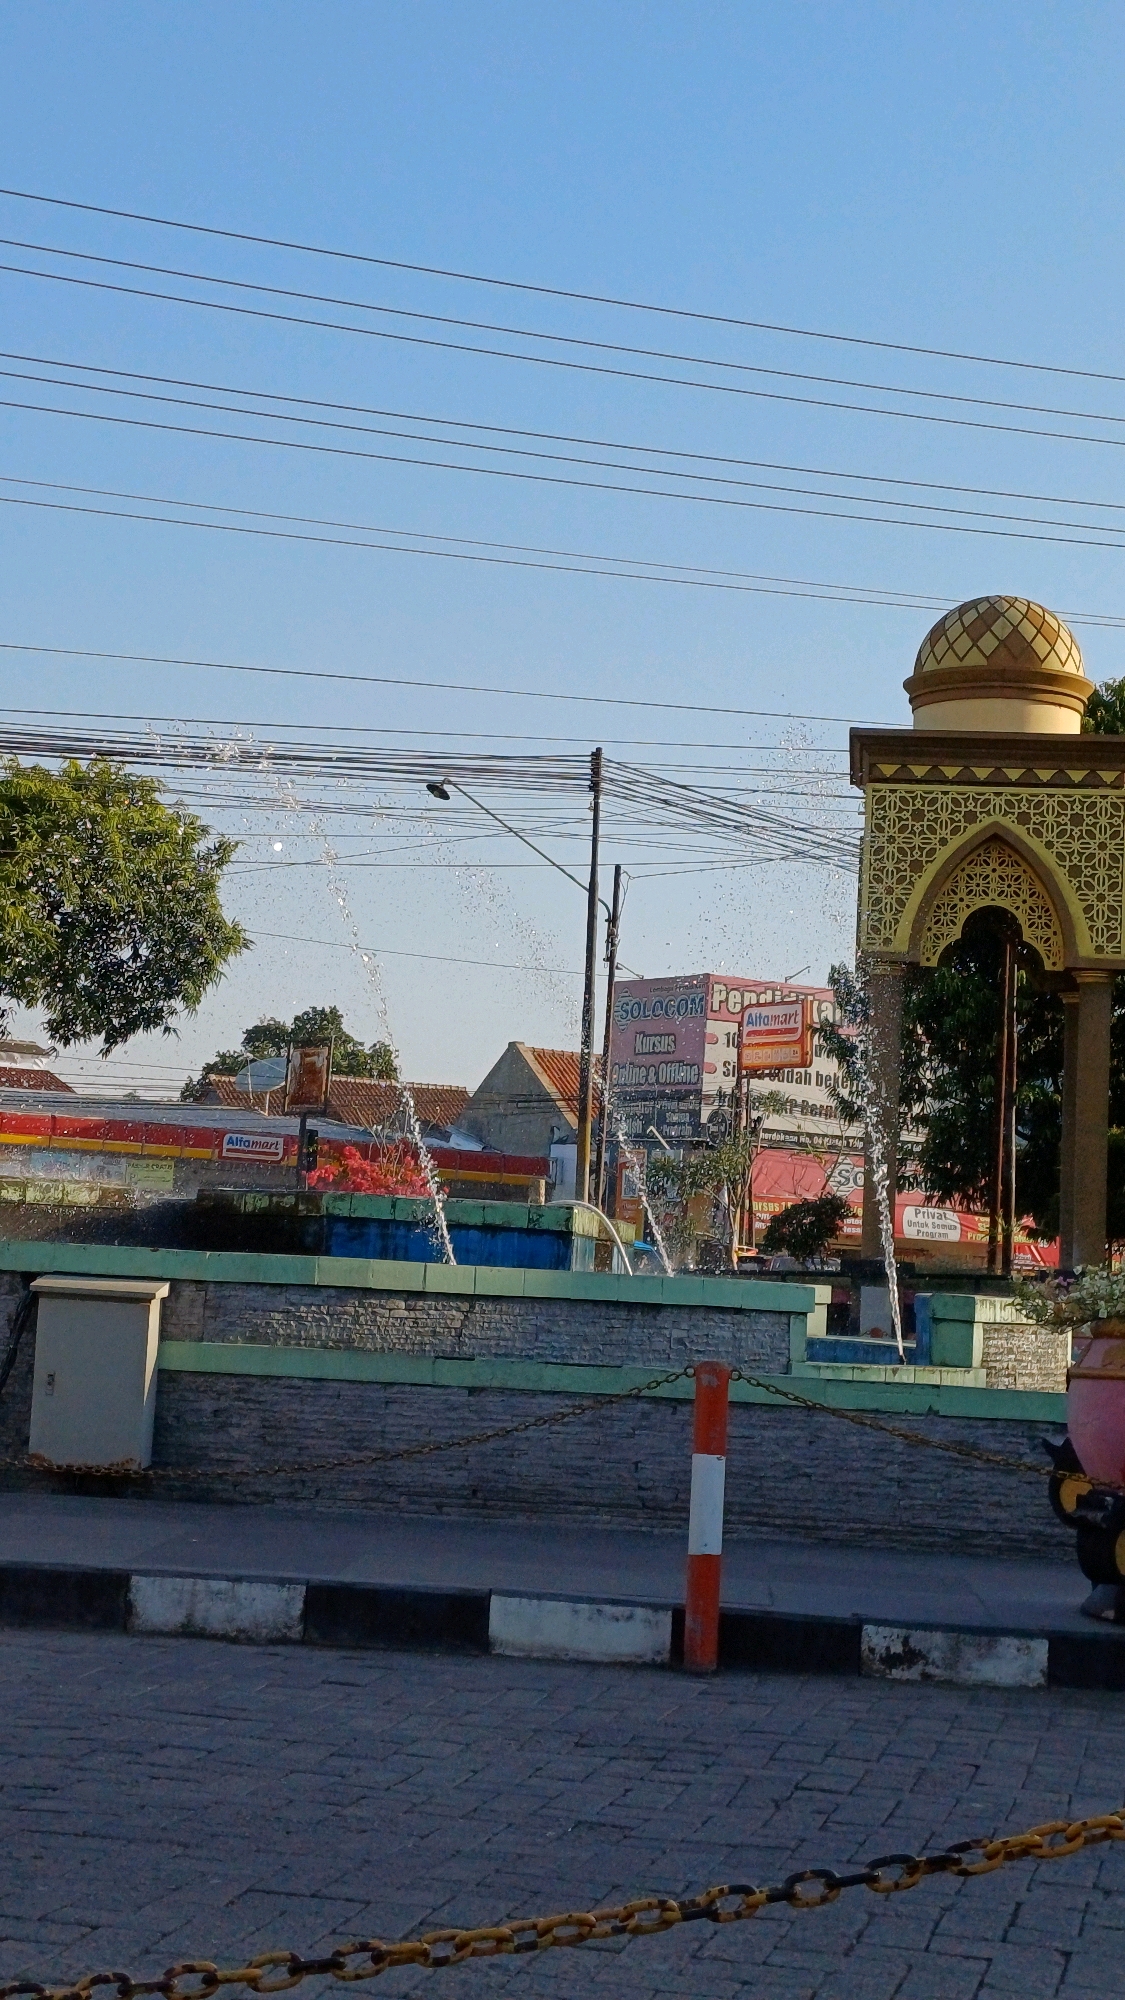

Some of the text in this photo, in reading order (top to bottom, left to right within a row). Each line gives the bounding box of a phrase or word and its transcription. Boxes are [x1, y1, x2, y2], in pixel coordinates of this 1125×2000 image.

[619, 994, 706, 1020] SOLOCOM
[746, 1009, 800, 1027] Alfamart
[634, 1031, 677, 1055] Kursus
[658, 1061, 700, 1086] Offline
[226, 1135, 281, 1150] Alfamart
[914, 1207, 947, 1220] Privat
[916, 1229, 949, 1239] Program
